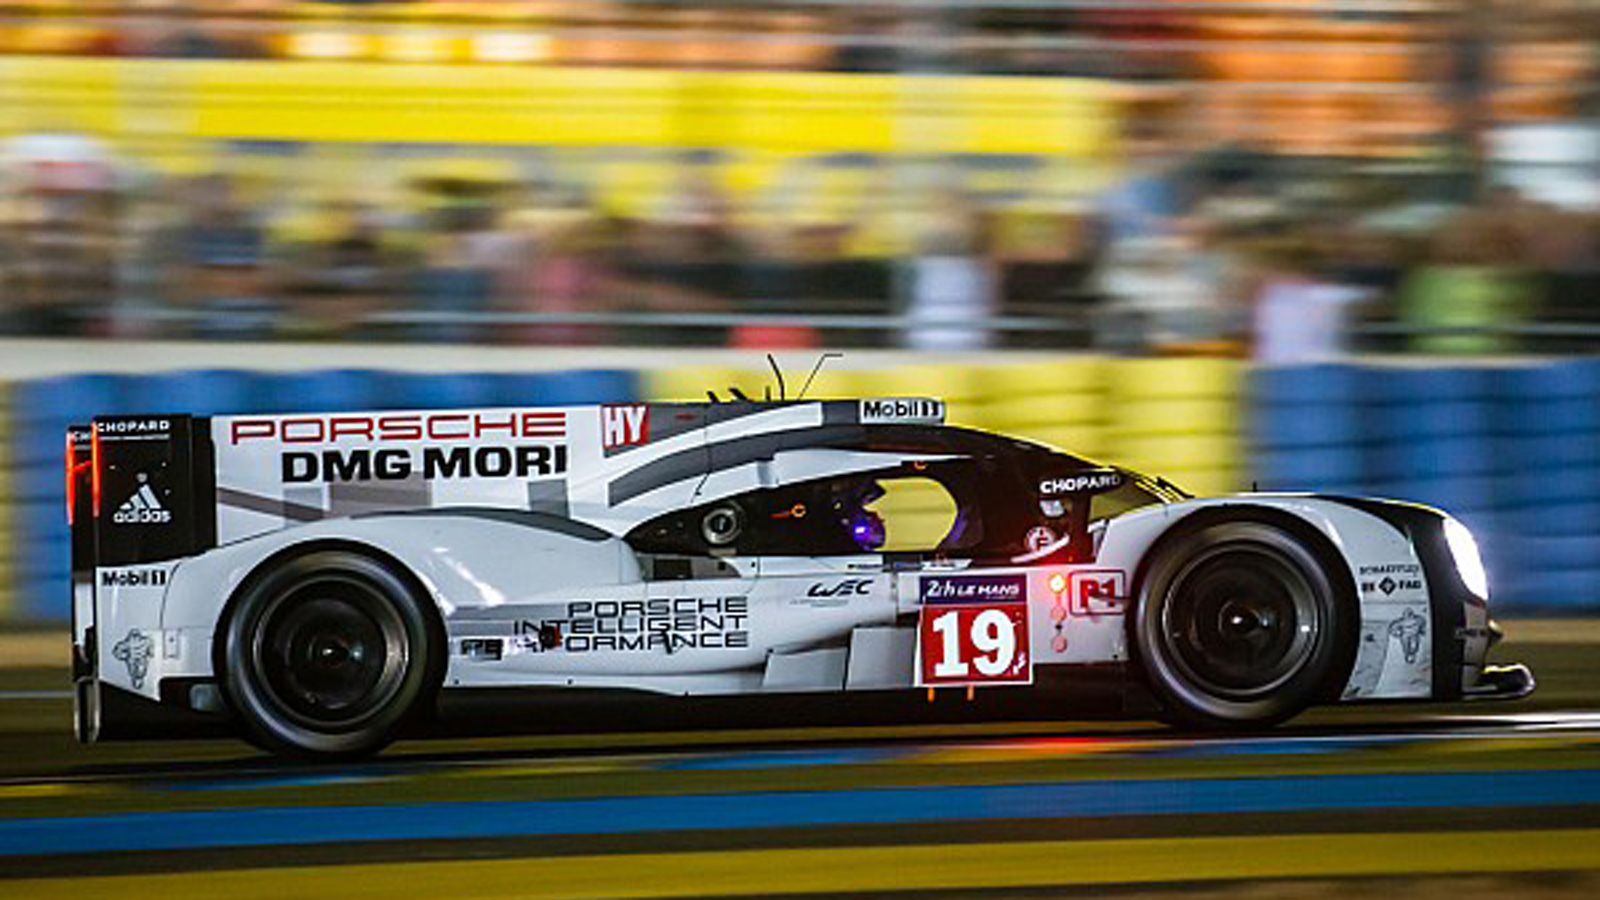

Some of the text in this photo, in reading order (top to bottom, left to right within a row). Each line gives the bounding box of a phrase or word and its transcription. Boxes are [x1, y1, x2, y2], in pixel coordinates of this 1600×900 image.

[864, 401, 919, 417] Mobil
[97, 420, 170, 432] CHOPARD
[231, 412, 567, 444] PORSCHE
[603, 406, 646, 446] HY
[281, 445, 567, 482] DMG MORI
[1040, 474, 1121, 493] CHOPARD
[113, 507, 172, 523] adidas
[102, 571, 148, 585] Mobil
[807, 580, 874, 597] WEC
[957, 584, 975, 596] LE
[978, 583, 1020, 595] MANS
[568, 597, 748, 618] PORSCHE
[514, 615, 747, 635] INTELLIGENT
[933, 609, 1015, 677] 19
